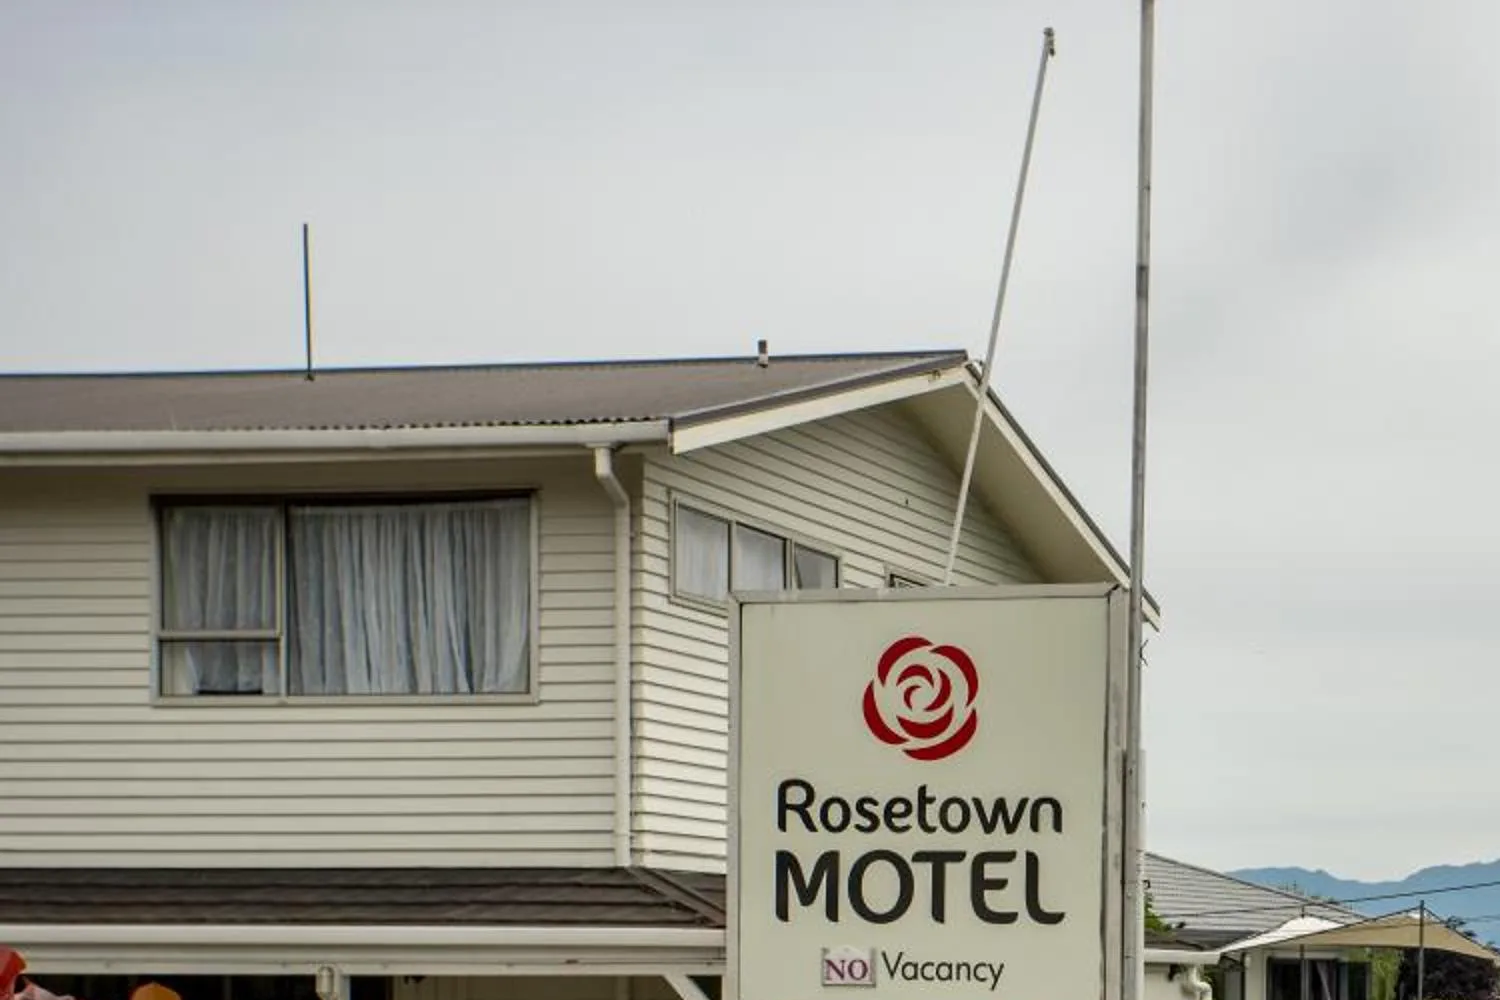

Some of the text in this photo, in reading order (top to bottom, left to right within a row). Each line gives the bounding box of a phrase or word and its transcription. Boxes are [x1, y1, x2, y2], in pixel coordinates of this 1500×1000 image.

[776, 778, 1064, 835] Rosetown
[775, 849, 1066, 925] MOTEL
[825, 951, 1005, 991] NO Vacancy
